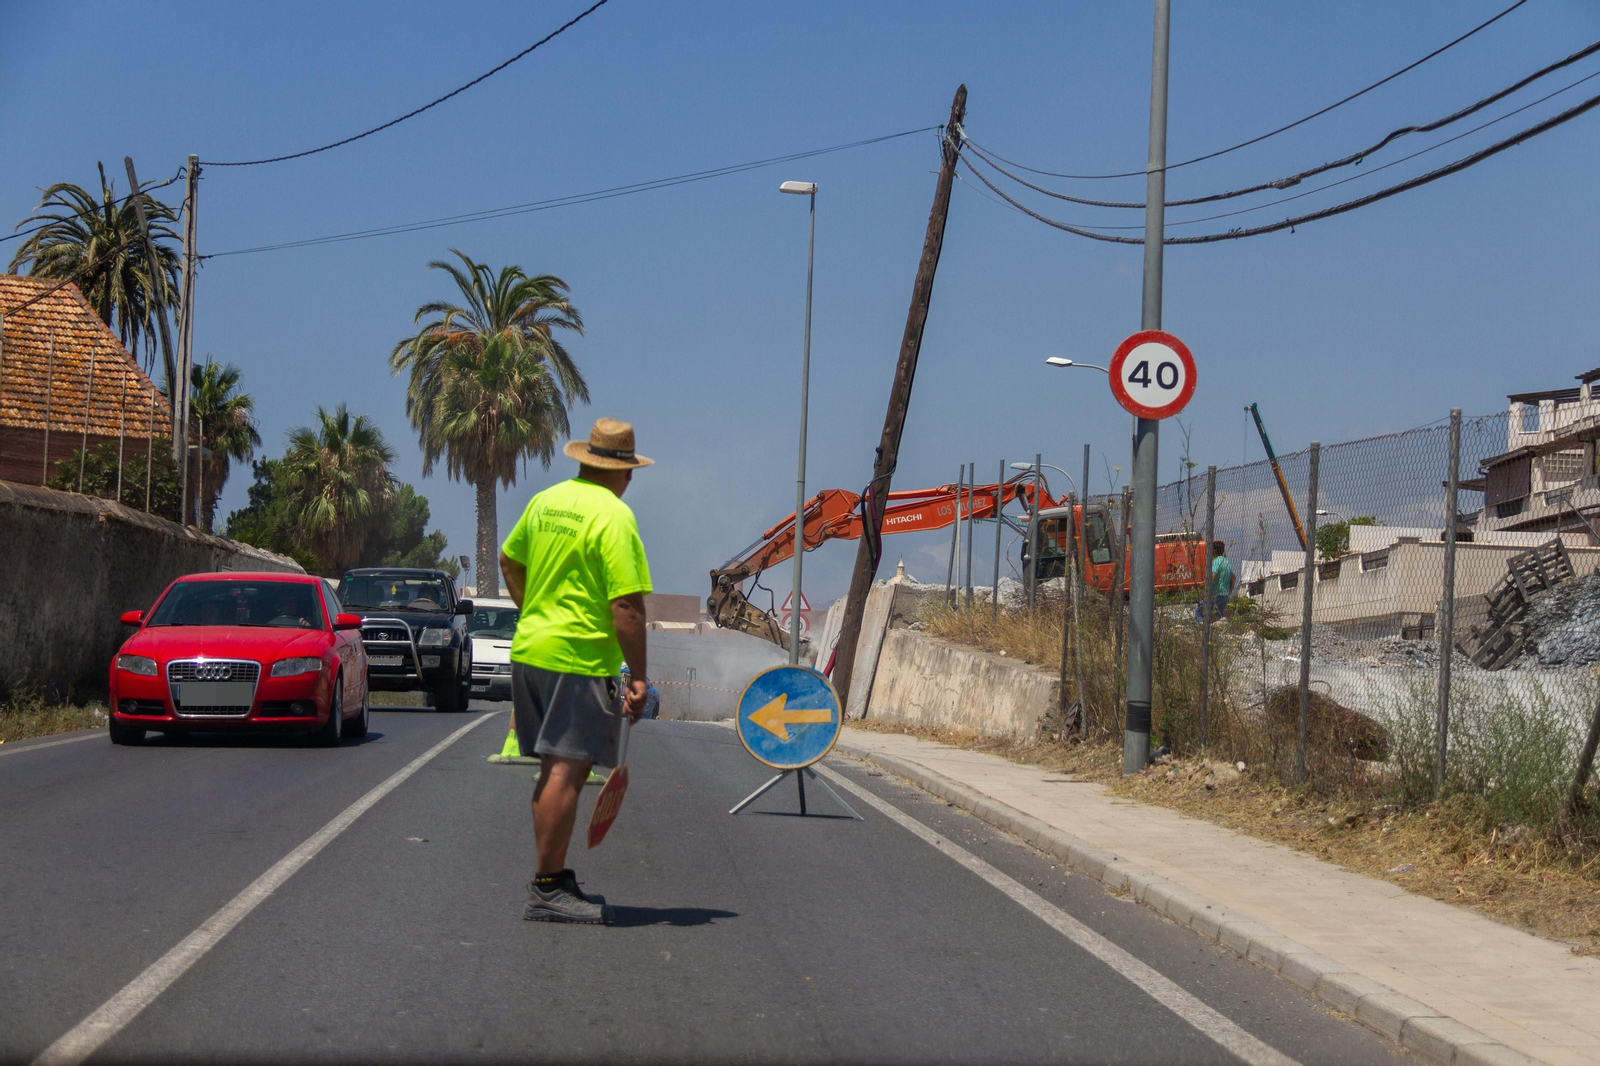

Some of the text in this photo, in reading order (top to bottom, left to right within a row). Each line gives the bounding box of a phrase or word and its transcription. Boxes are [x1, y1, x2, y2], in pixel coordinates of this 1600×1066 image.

[1128, 360, 1179, 390] 40
[937, 505, 952, 516] LOS
[886, 513, 922, 525] HITACHI
